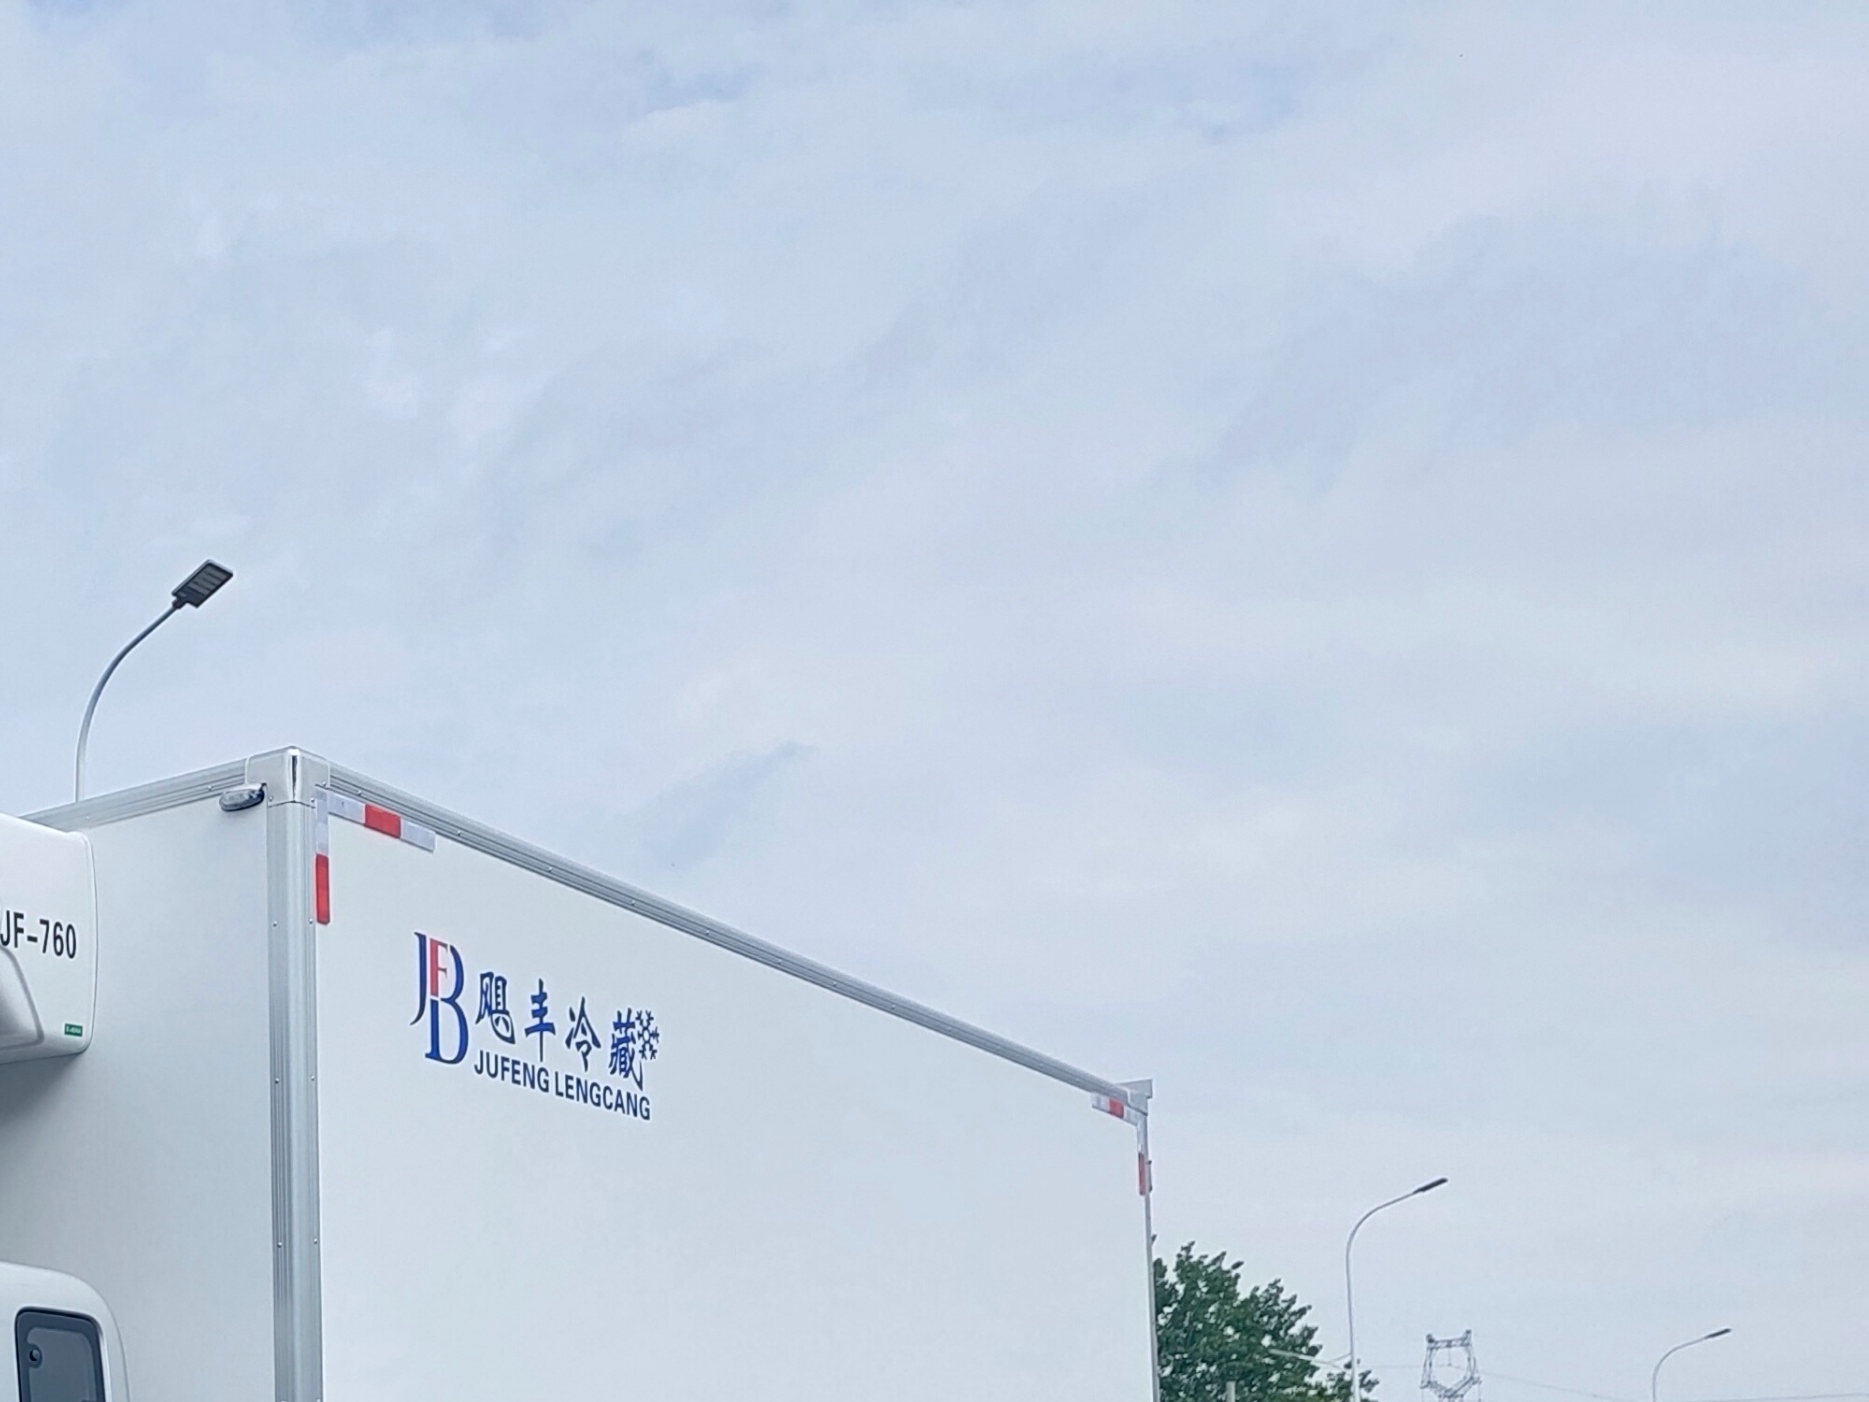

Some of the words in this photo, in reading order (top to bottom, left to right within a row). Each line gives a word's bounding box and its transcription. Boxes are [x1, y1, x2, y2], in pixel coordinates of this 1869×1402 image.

[0, 909, 77, 959] JF-760
[474, 1050, 550, 1093] JUFENG
[554, 1071, 651, 1121] LENGCANG
